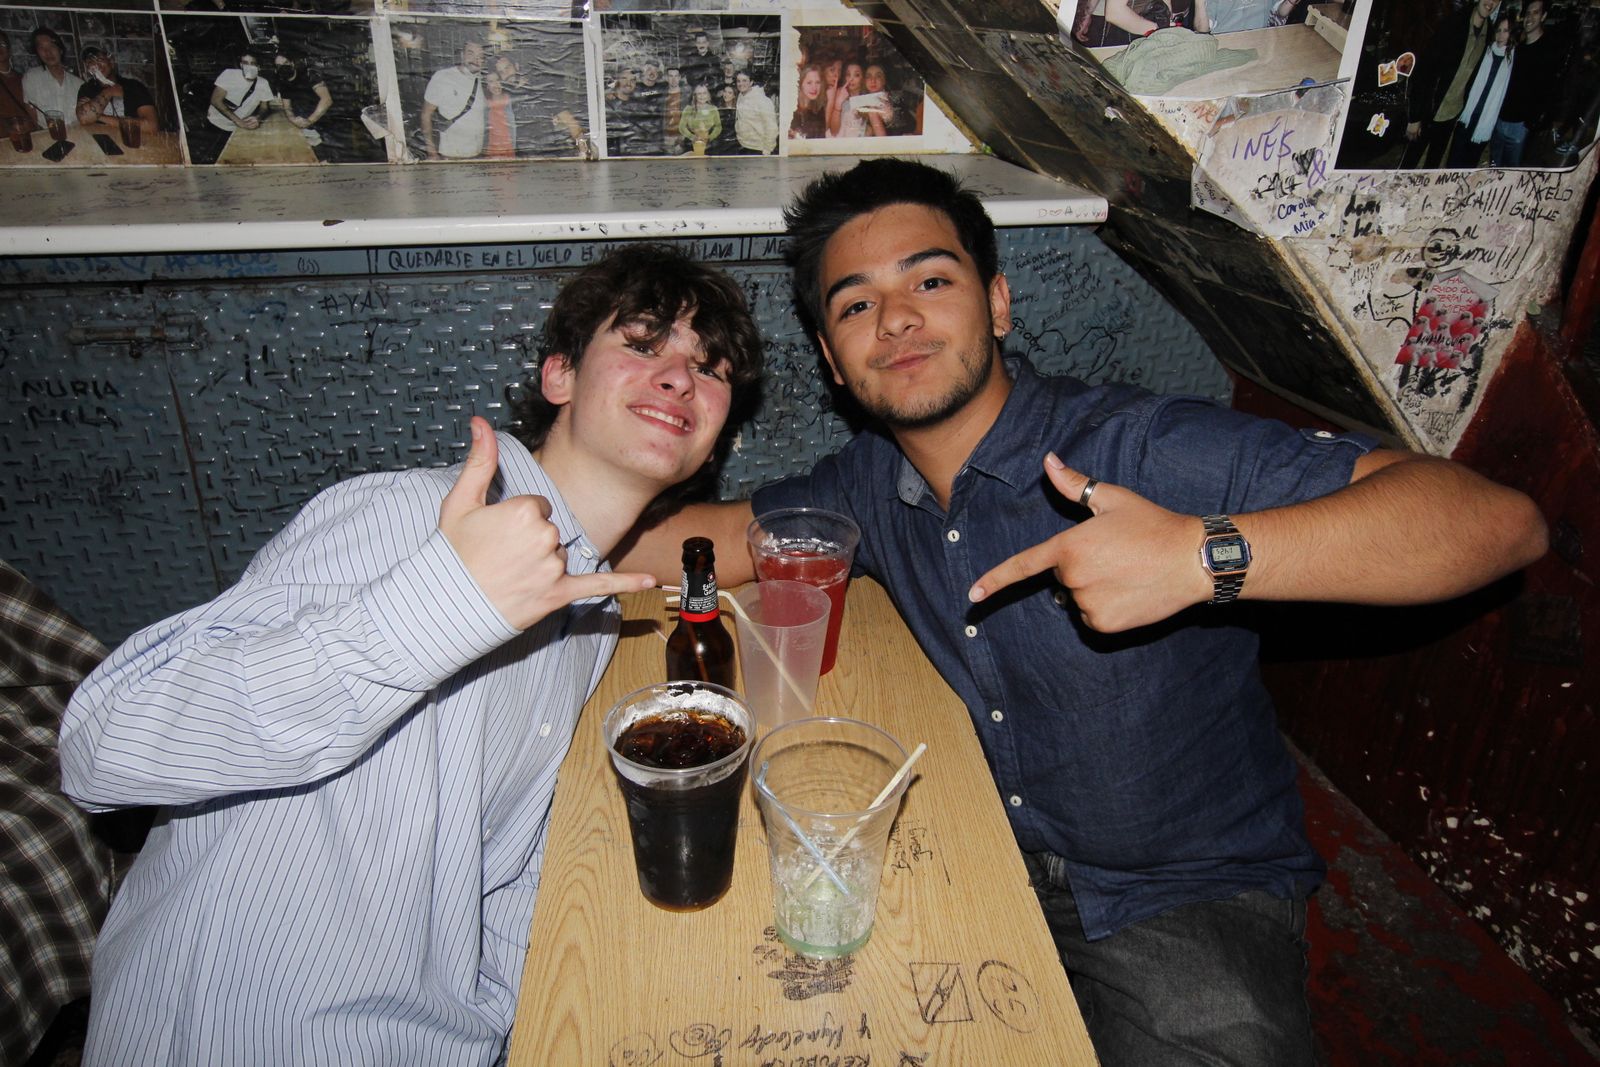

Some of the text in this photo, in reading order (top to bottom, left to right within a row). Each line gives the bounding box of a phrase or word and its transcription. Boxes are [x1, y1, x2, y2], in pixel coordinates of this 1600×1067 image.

[1232, 116, 1294, 161] INÉS
[388, 249, 474, 271] QUEDARSE
[482, 252, 500, 267] EN
[505, 248, 527, 268] EL
[530, 245, 573, 267] SUELO
[702, 242, 735, 260] LAVA
[21, 379, 119, 400] NURIA
